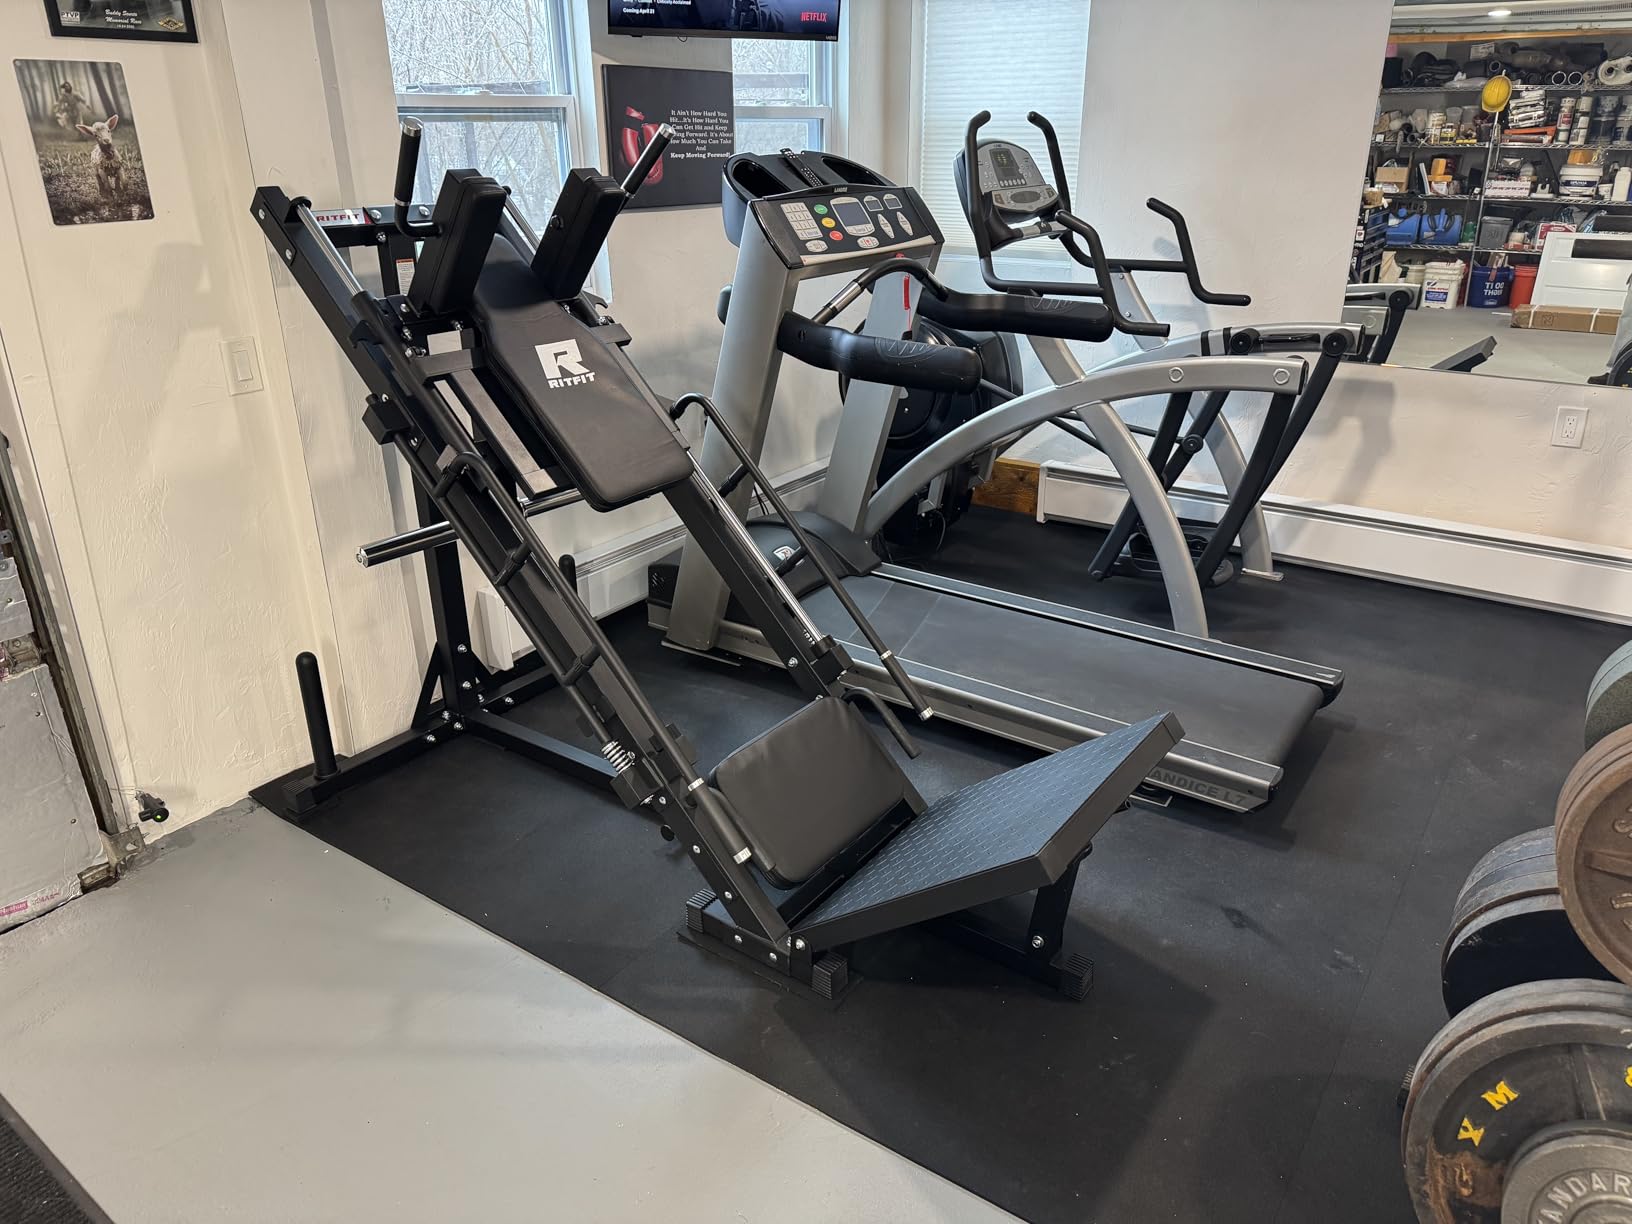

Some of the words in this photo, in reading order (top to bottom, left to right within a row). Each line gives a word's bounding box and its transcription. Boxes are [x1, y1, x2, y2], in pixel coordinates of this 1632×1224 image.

[801, 12, 827, 22] NETFLIX
[316, 213, 360, 222] RITFIT
[548, 372, 595, 389] RITFIT
[1151, 769, 1219, 796] ANDICE
[1536, 1172, 1631, 1224] ANDAR
